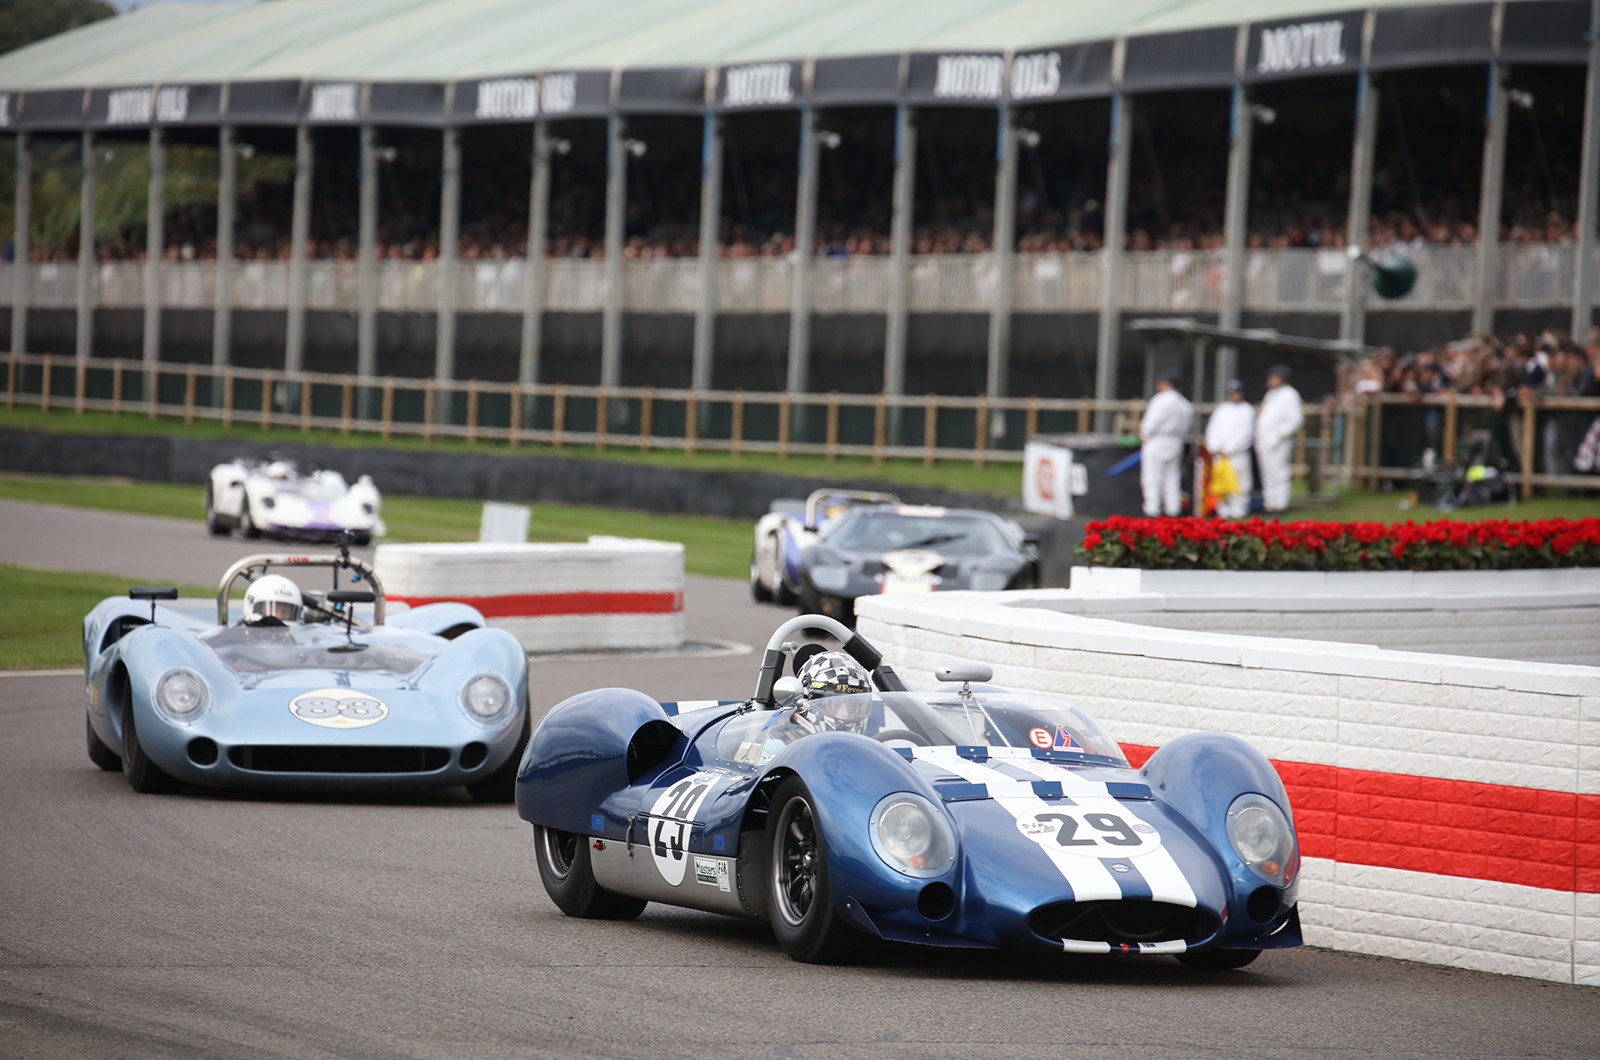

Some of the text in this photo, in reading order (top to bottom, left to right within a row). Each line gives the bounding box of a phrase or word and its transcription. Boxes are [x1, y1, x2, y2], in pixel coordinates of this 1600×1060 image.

[1256, 20, 1346, 74] MOTUL
[724, 63, 794, 107] MOTUL
[1010, 51, 1061, 100] OILS
[1034, 731, 1048, 744] E
[655, 781, 708, 860] 29
[1034, 813, 1143, 846] 29
[696, 861, 716, 876] Masters
